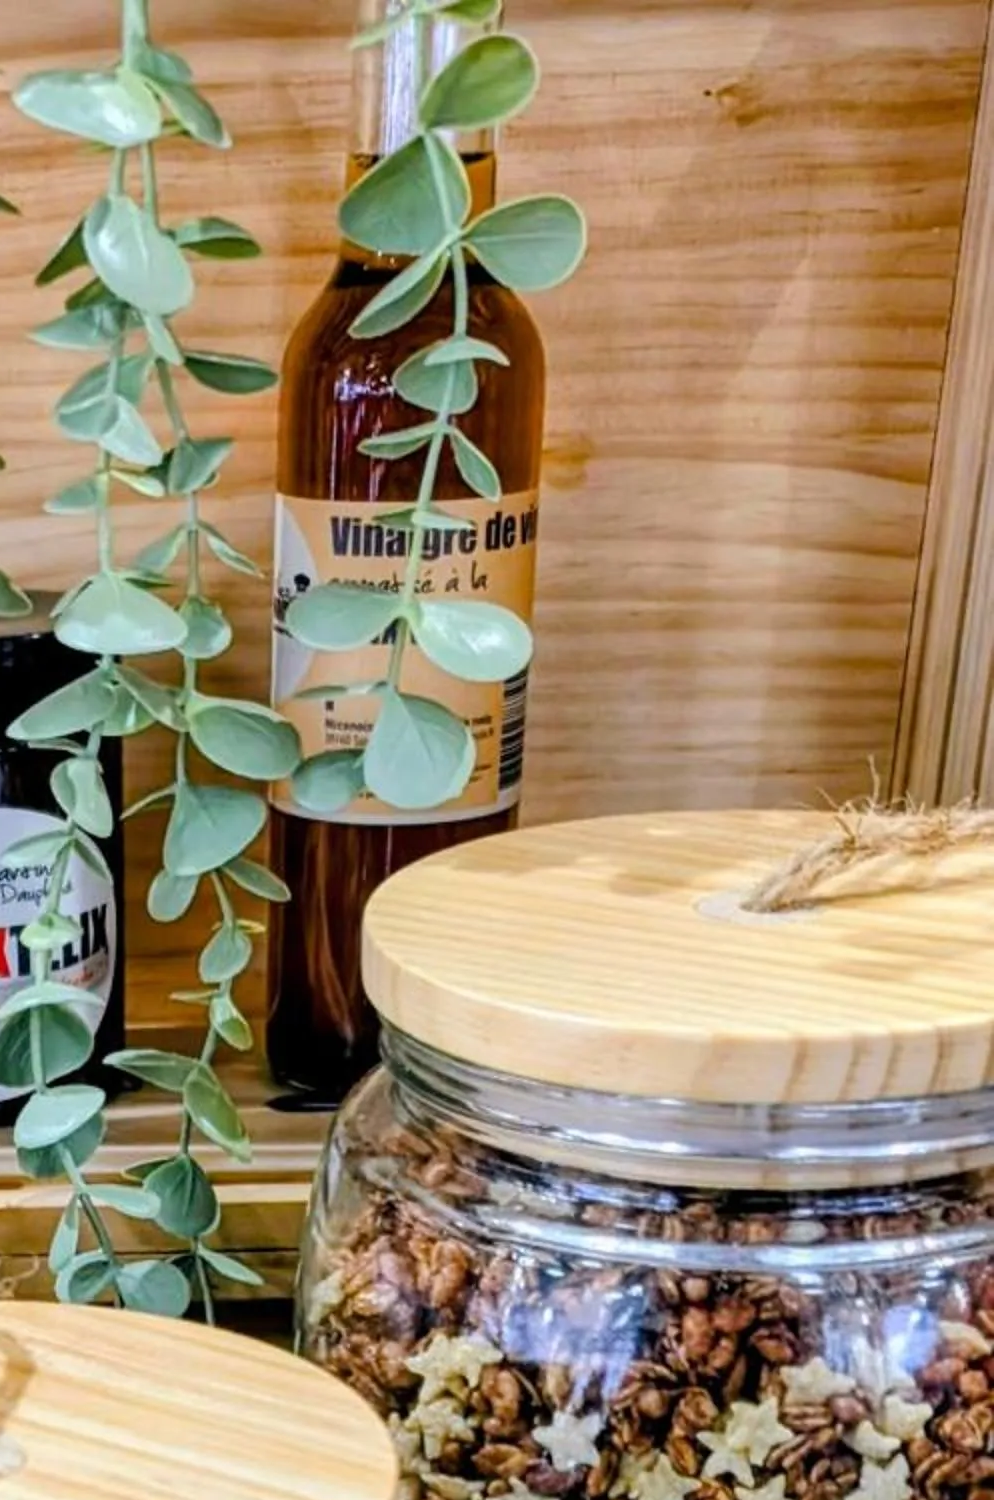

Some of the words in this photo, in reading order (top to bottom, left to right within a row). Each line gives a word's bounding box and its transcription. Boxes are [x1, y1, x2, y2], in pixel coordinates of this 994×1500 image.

[330, 515, 478, 560] Vinagre
[485, 510, 516, 550] de
[521, 505, 539, 544] vi
[471, 559, 489, 591] la
